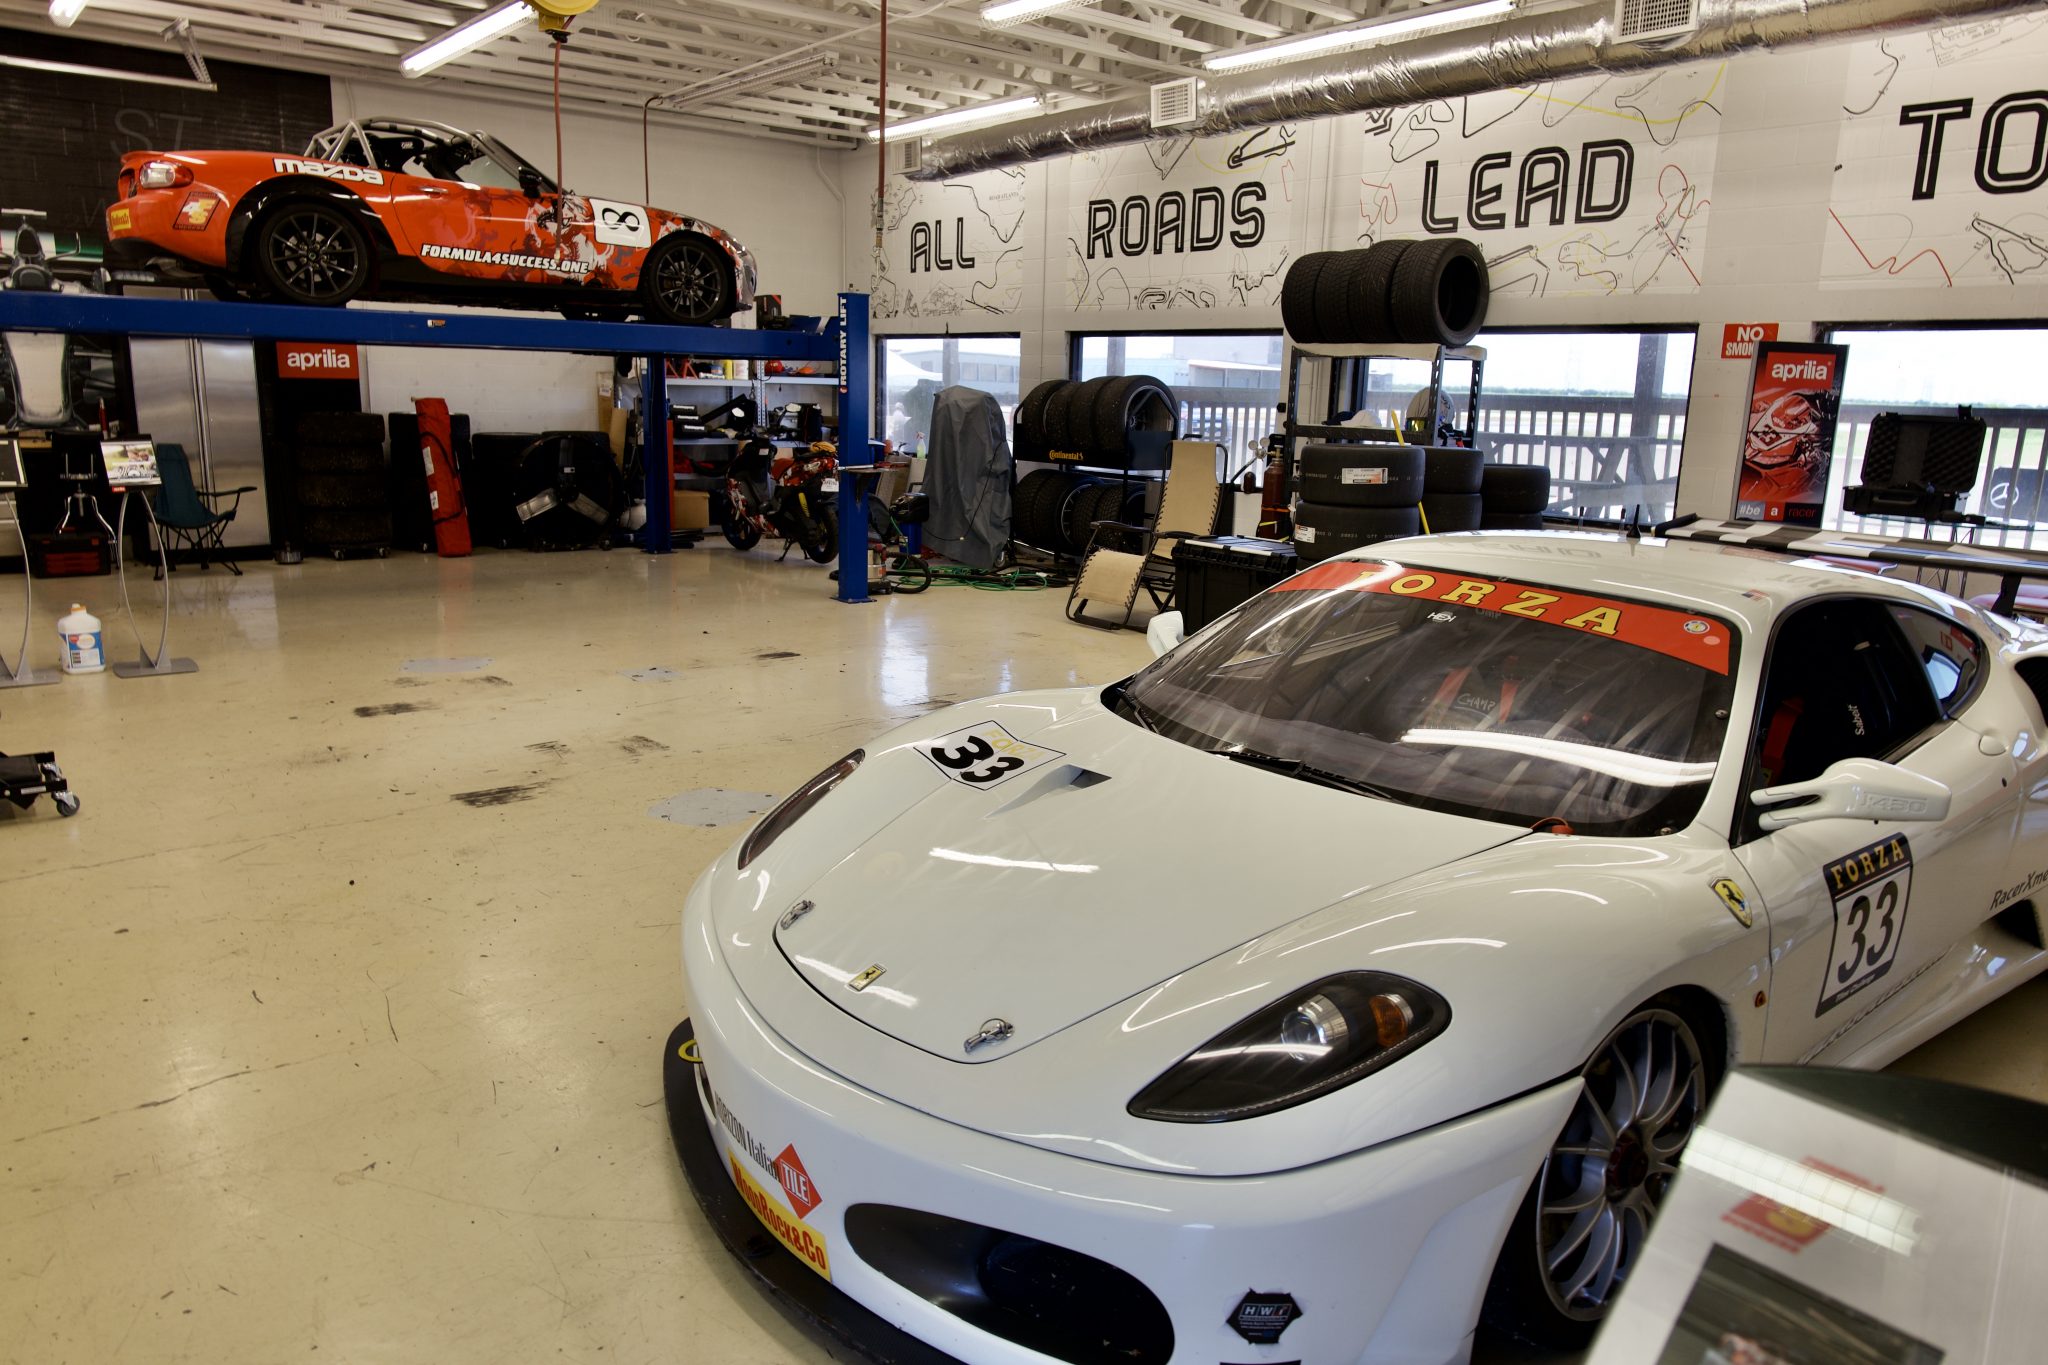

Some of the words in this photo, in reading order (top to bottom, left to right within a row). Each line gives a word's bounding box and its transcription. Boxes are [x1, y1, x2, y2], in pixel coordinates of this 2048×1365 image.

[910, 217, 976, 274] ALL
[1086, 181, 1267, 260] ROADS
[1421, 138, 1635, 234] LEAD
[1899, 89, 2048, 201] TO
[421, 244, 589, 275] FORMULA4SUCCESS.ONE
[1737, 327, 1764, 341] NO
[287, 349, 351, 370] aprilia
[1771, 361, 1828, 381] aprilia
[1049, 450, 1080, 461] Continental
[1770, 507, 1778, 516] a
[1848, 704, 1865, 736] Sabelt
[931, 735, 1025, 783] 33
[1831, 838, 1905, 890] FORZA
[1837, 880, 1899, 985] 33
[746, 1130, 782, 1184] Italian
[781, 1162, 809, 1202] TILE
